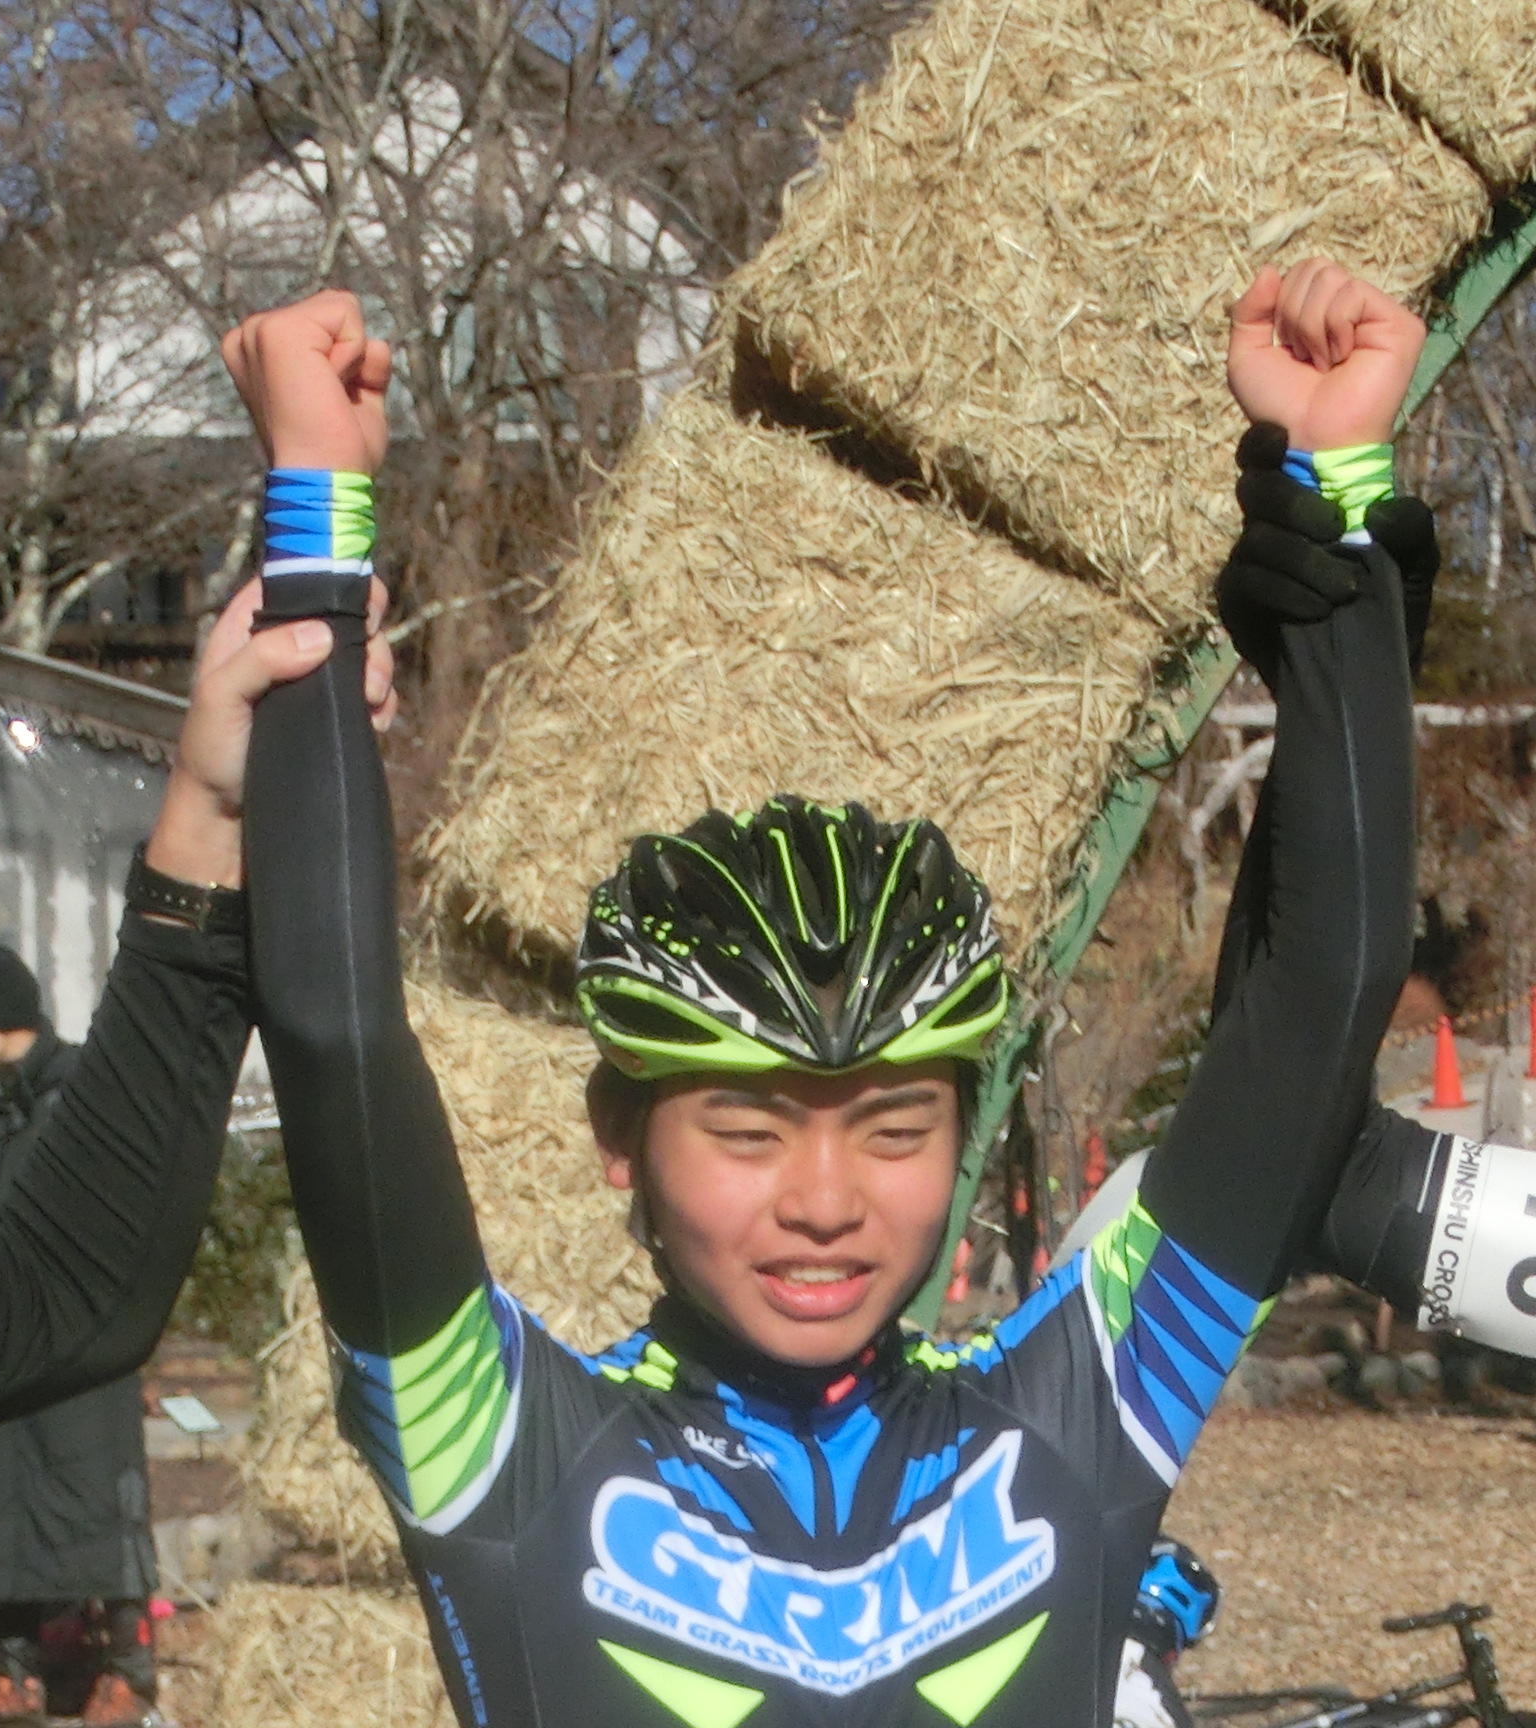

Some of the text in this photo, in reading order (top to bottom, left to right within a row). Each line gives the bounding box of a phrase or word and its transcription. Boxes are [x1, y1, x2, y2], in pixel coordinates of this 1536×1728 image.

[1442, 1141, 1484, 1244] SHINSHU
[593, 1577, 678, 1628] TEAM
[689, 1621, 790, 1669] GRASS
[900, 1551, 1046, 1658] MOVEMENT
